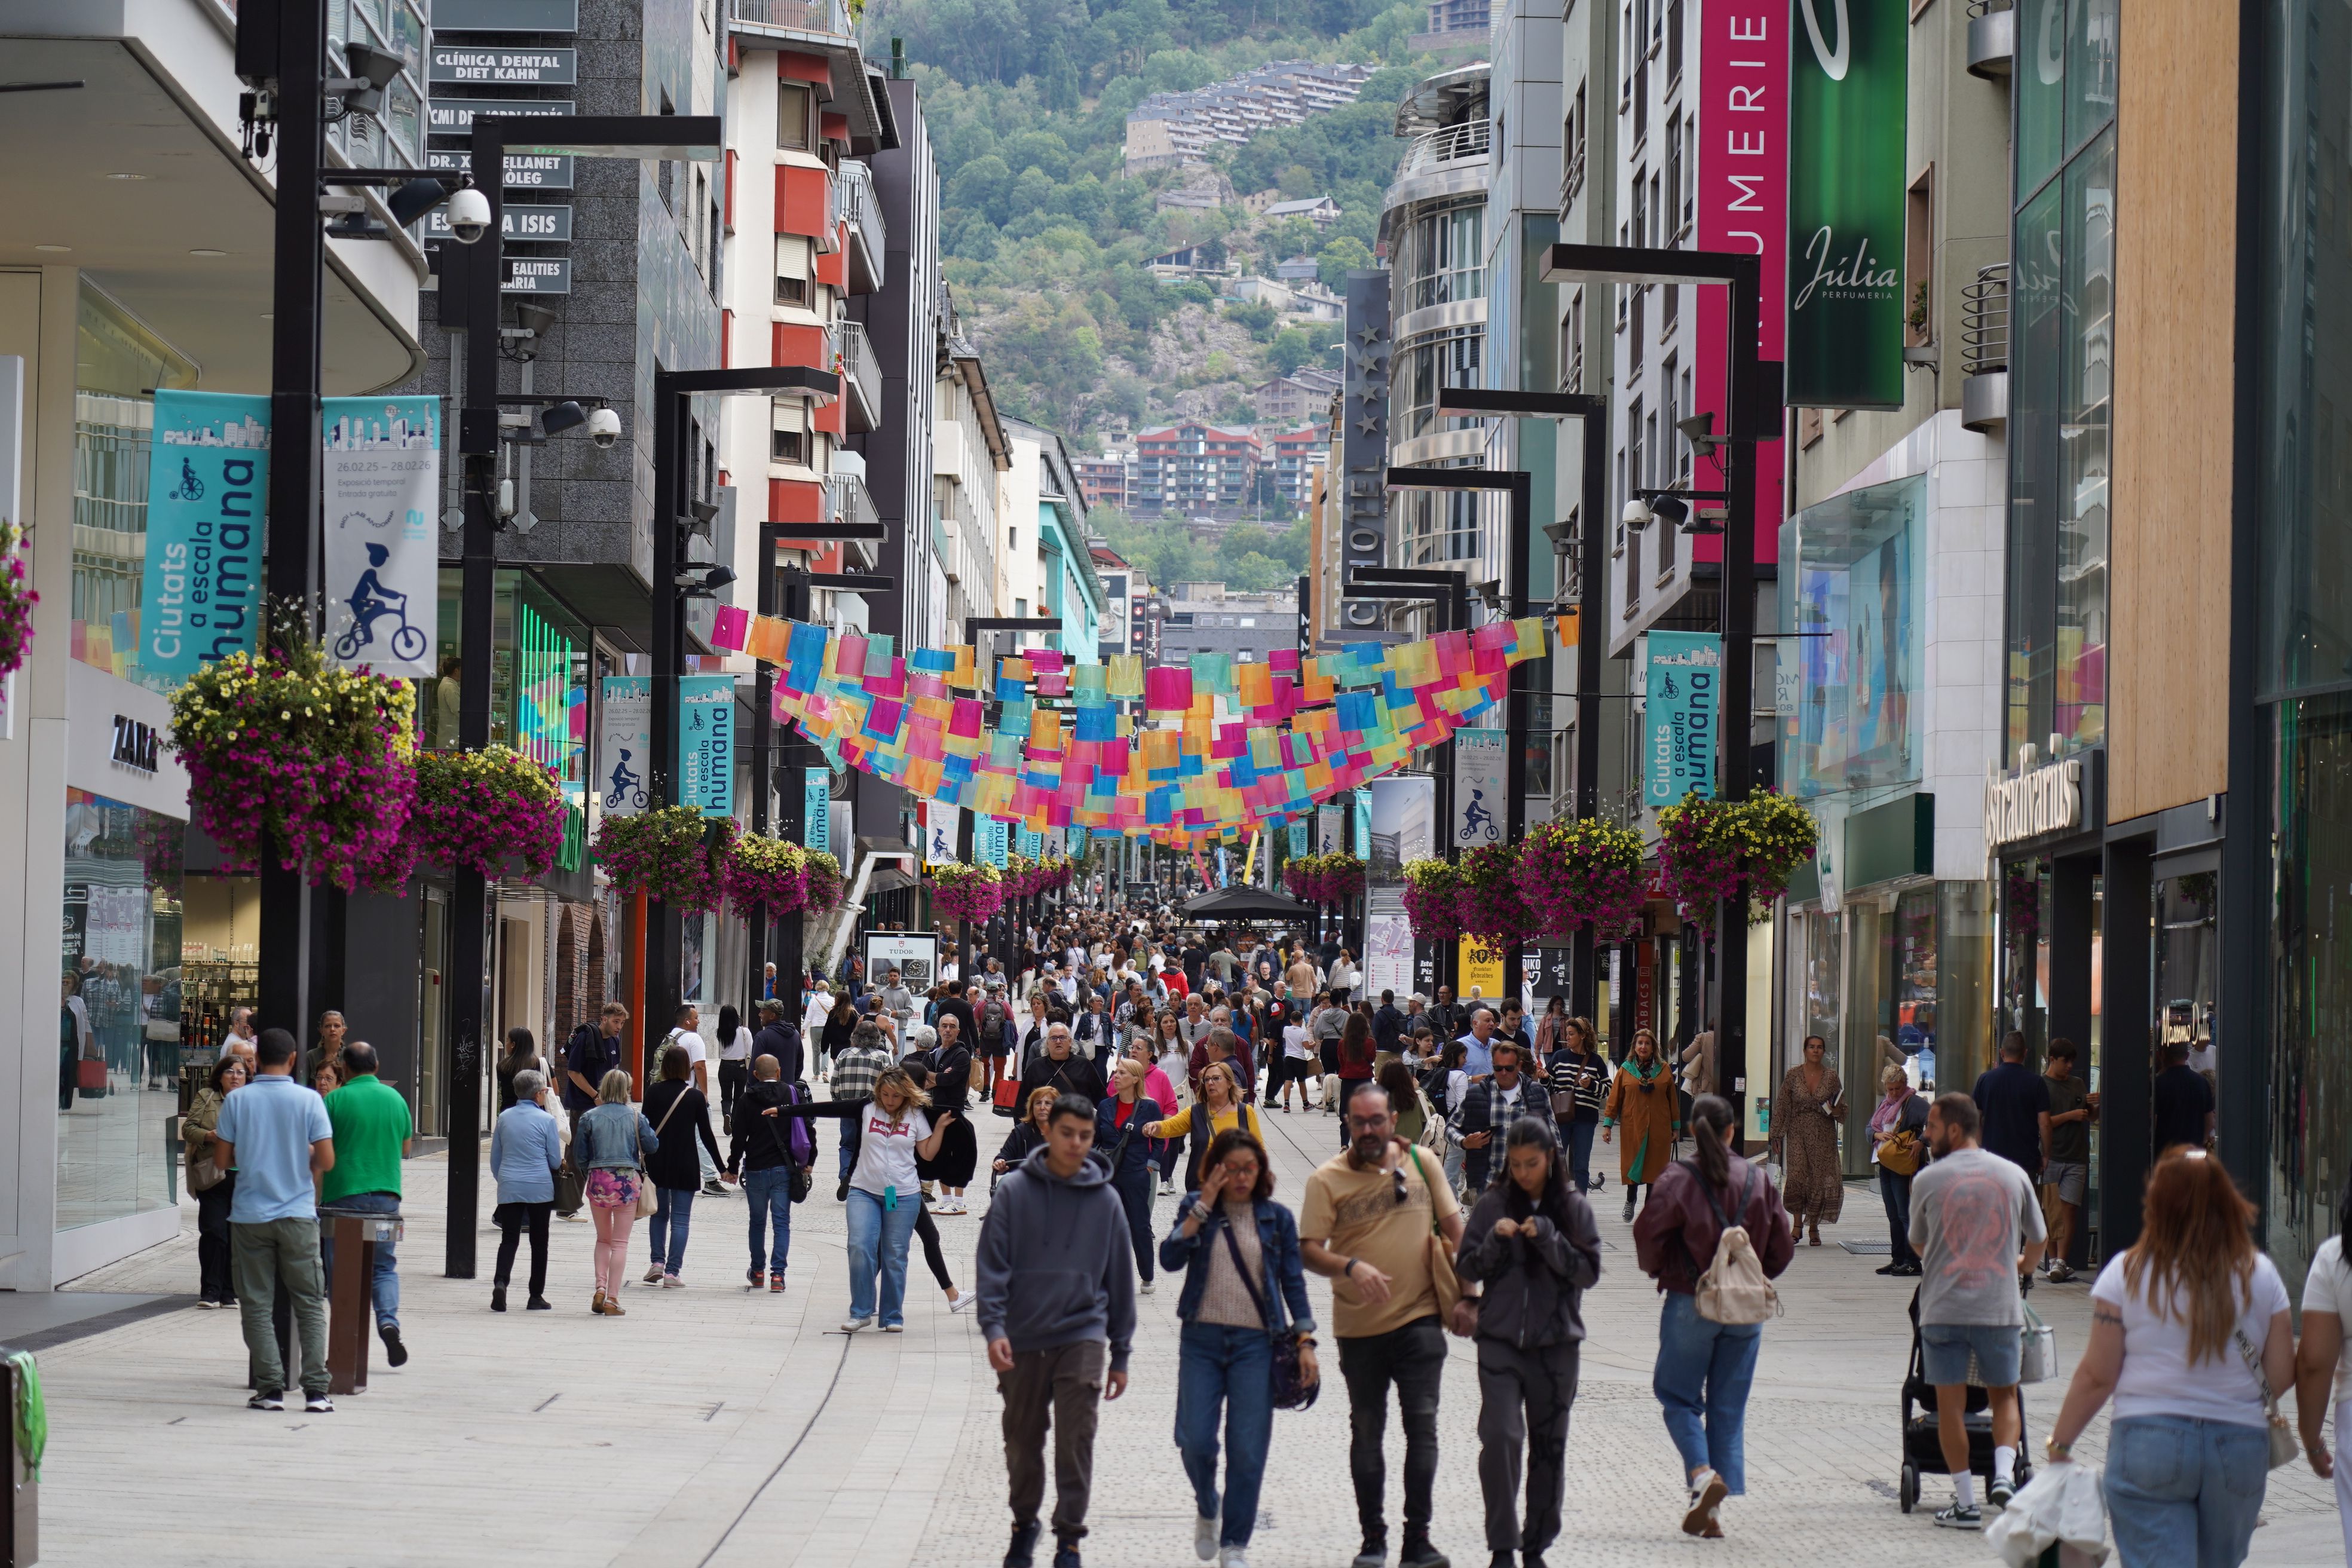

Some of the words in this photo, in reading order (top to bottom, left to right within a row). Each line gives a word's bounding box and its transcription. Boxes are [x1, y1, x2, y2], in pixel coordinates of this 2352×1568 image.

[436, 51, 496, 66] CLÍNICA
[502, 56, 560, 68] DENTAL
[456, 67, 489, 79] DIET
[495, 68, 540, 79] KAHN
[430, 109, 454, 124] CMI
[430, 155, 455, 167] DR.
[503, 157, 561, 169] ELLANET
[521, 215, 556, 233] ISIS
[513, 263, 560, 276] EALITIES
[1794, 225, 1898, 311] Júlia
[337, 462, 379, 471] 26.02.25
[391, 461, 431, 471] 28.02.26
[373, 478, 406, 486] temporal
[189, 521, 213, 604] escala
[198, 458, 255, 662] humana
[152, 543, 187, 659] Ciutats
[191, 613, 207, 628] a
[111, 713, 159, 773] ZARA
[1671, 712, 1685, 762] escala
[1682, 673, 1710, 797] humana
[699, 740, 709, 782] escala
[705, 708, 727, 810] humana
[1653, 725, 1671, 797] Ciutats
[1675, 768, 1685, 777] a
[700, 785, 708, 794] a
[1640, 984, 1649, 1028] ABACS
